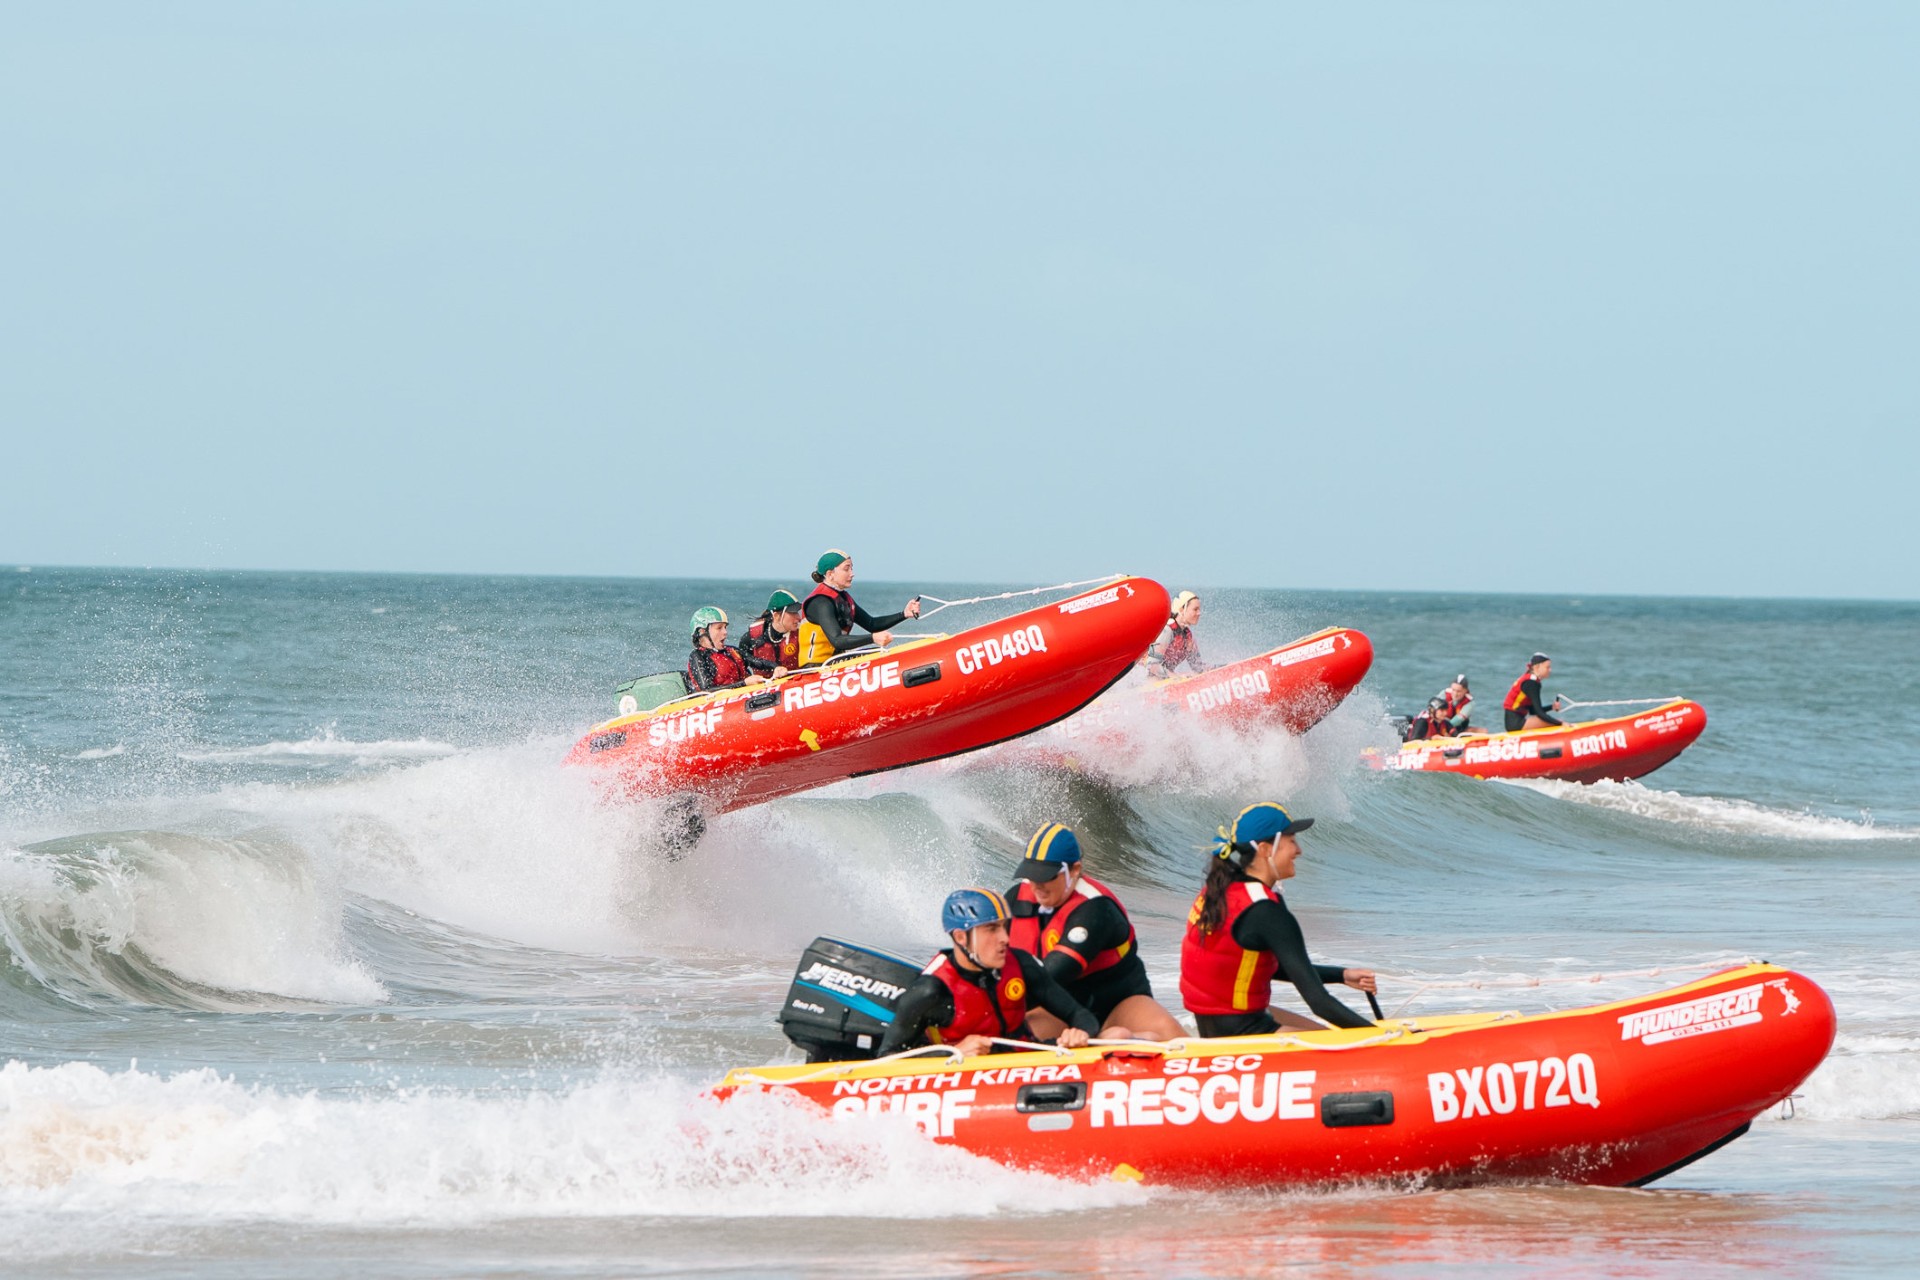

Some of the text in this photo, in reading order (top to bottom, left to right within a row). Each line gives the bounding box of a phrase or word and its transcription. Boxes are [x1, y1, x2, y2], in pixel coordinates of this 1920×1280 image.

[956, 625, 1048, 675] CFD48Q
[648, 661, 900, 747] SURF RESCUE
[650, 685, 782, 724] DICKY BEACH
[1465, 741, 1539, 765] RESCUE
[1570, 729, 1627, 757] BZQ17Q
[799, 962, 906, 1000] MERCURY
[1617, 983, 1764, 1040] THUNDERCAT
[832, 1064, 1082, 1095] NORTH KIRRA
[1163, 1054, 1263, 1075] SLSC
[1090, 1070, 1317, 1127] RESCUE
[1427, 1053, 1601, 1123] BX072Q
